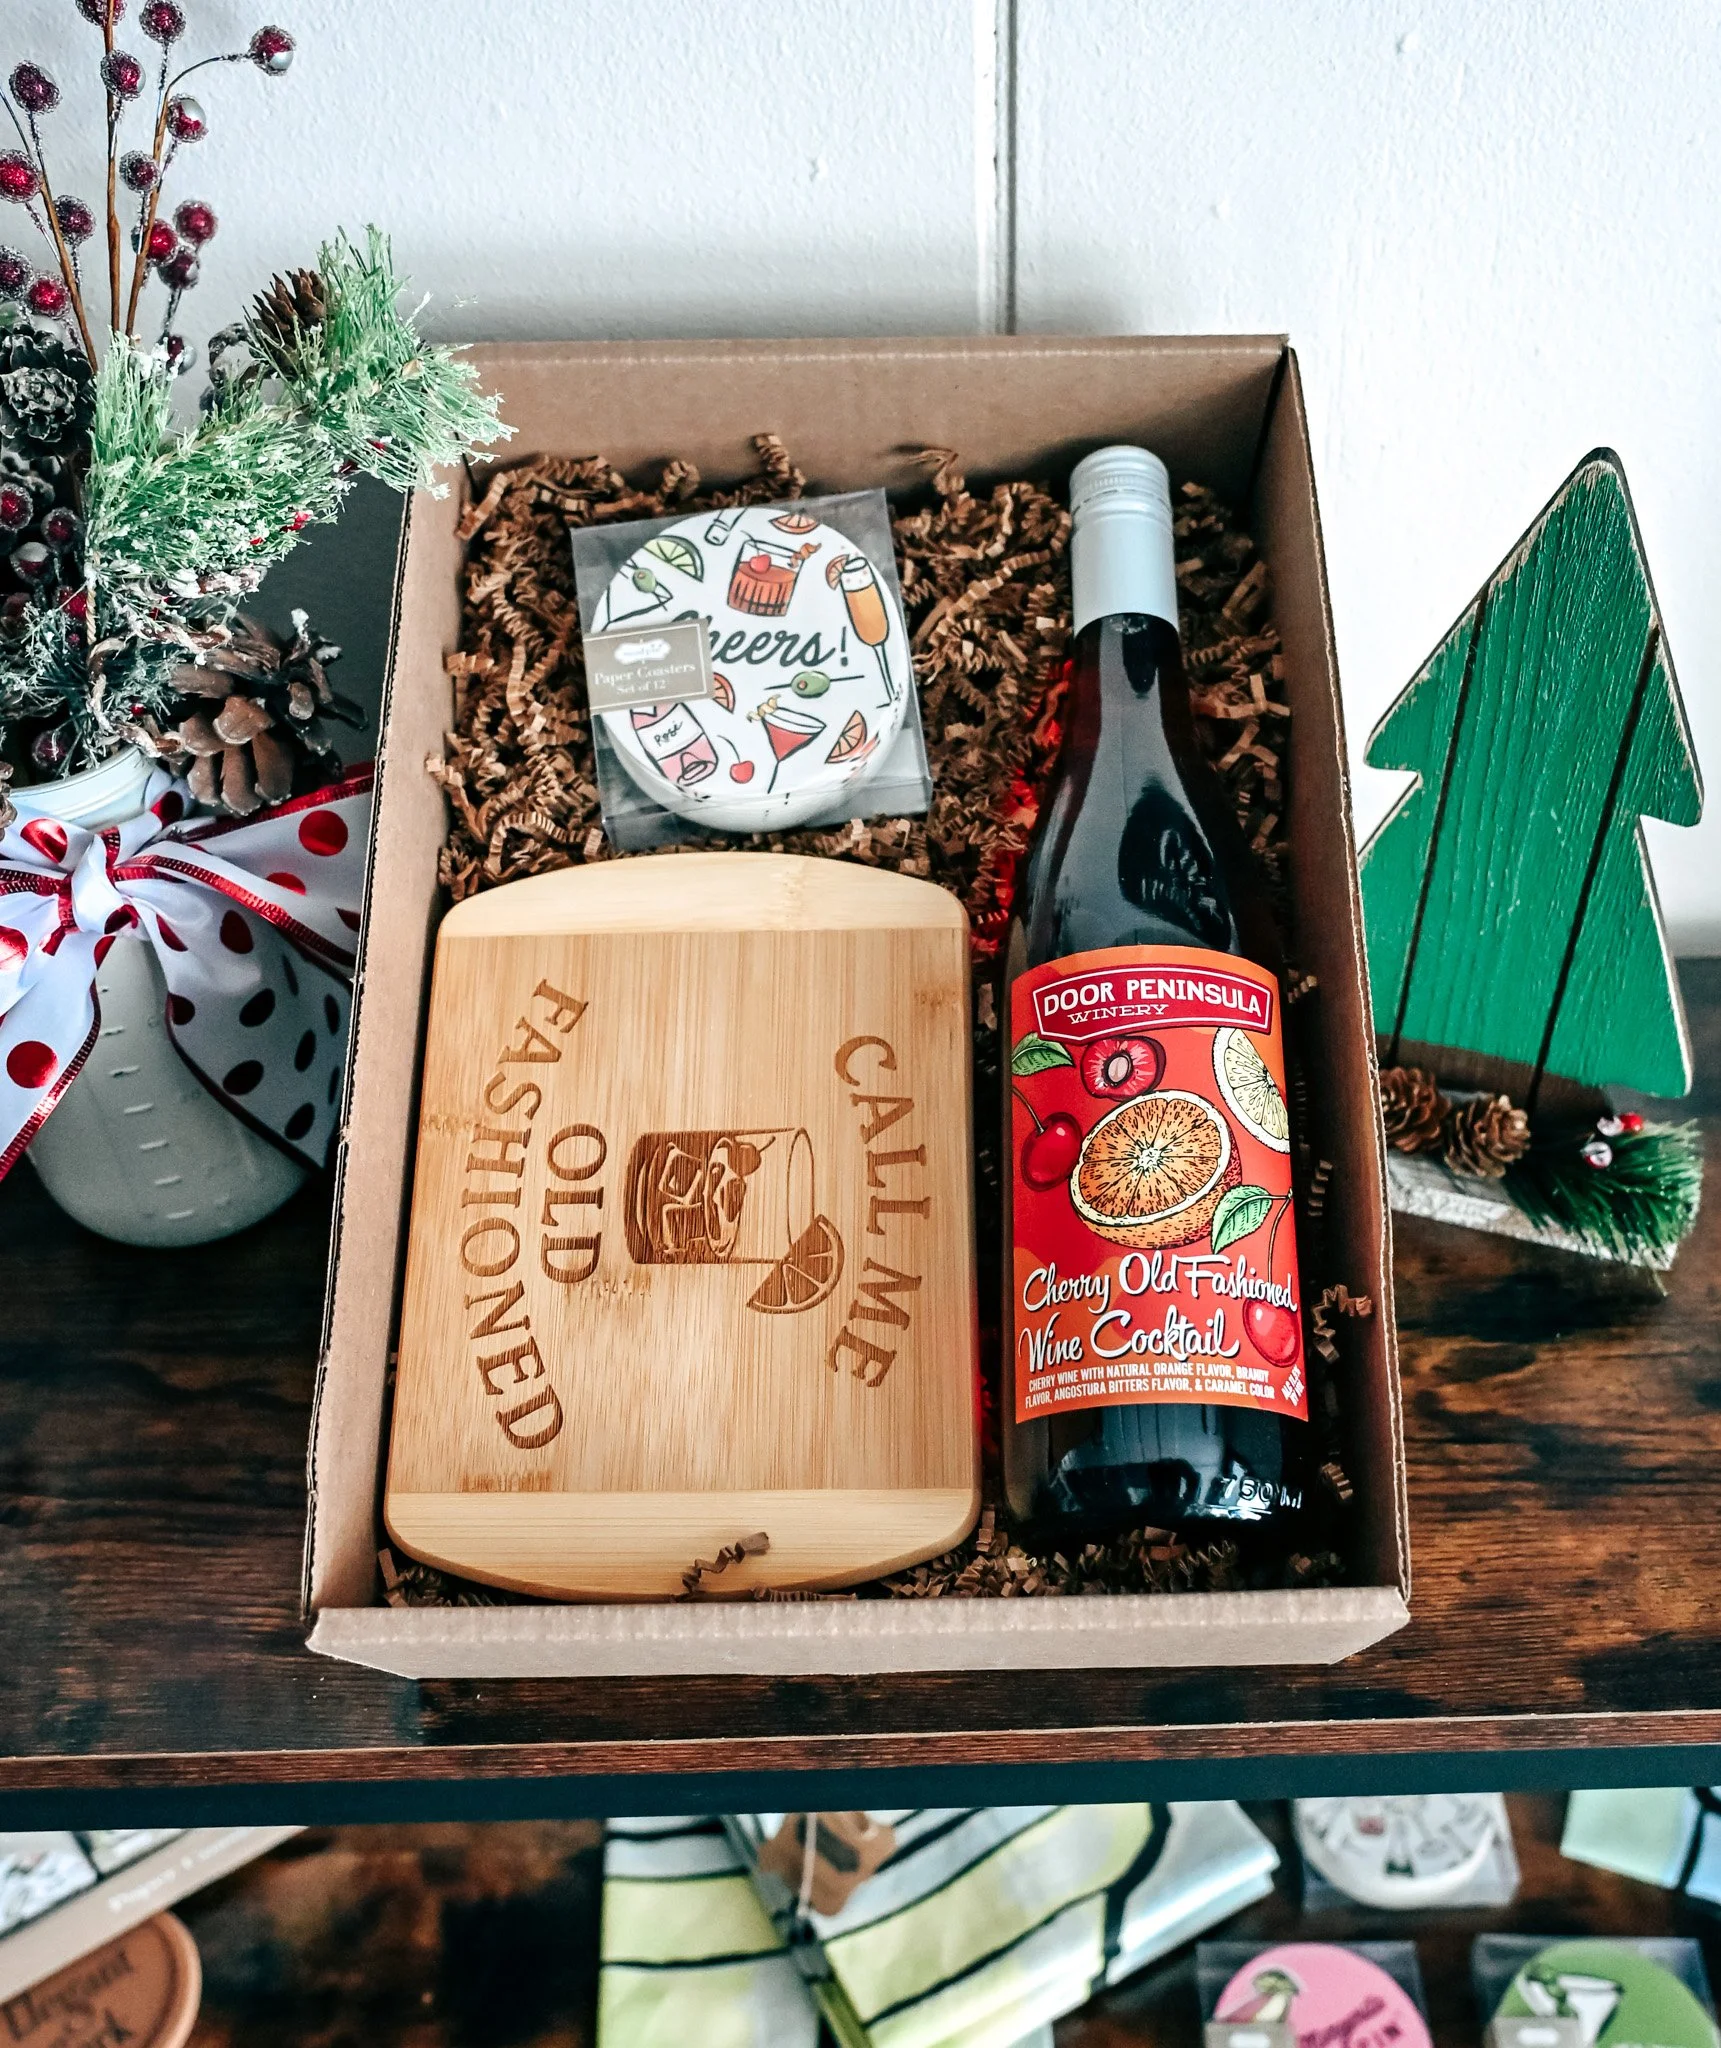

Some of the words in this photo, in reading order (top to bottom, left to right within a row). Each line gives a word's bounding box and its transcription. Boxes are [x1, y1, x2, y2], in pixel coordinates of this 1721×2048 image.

[594, 671, 634, 687] Paper
[637, 663, 697, 679] Coasters
[617, 685, 635, 695] Set
[638, 681, 650, 693] of
[654, 679, 667, 691] 12
[1043, 981, 1114, 1017] DOOR
[1126, 978, 1262, 1018] PENINSULA
[1067, 1003, 1170, 1025] WINERY
[834, 1034, 931, 1237] CALL
[459, 978, 589, 1450] FASHIONED
[540, 1123, 608, 1285] OLD
[1023, 1262, 1111, 1315] Cherry
[1119, 1250, 1178, 1296] Old
[1175, 1254, 1298, 1312] Fashioned
[825, 1256, 923, 1389] ME
[1019, 1312, 1084, 1374] Wine
[1090, 1305, 1240, 1361] Cocktail
[1025, 1391, 1053, 1409] FLAVOR,
[1054, 1381, 1107, 1402] ANGOSTURA
[1108, 1378, 1150, 1394] BITTERS
[1151, 1377, 1193, 1393] FLAVOR,
[1194, 1378, 1203, 1392] &
[1204, 1378, 1249, 1396] CARAMEL
[1249, 1382, 1276, 1400] COLOR
[1028, 1374, 1056, 1393] CHERRY
[1057, 1369, 1079, 1385] WINE
[1080, 1366, 1105, 1381] WITH
[1106, 1362, 1152, 1379] NATURAL
[1153, 1362, 1195, 1376] ORANGE
[1196, 1362, 1235, 1380] FLAVOR,
[1236, 1365, 1270, 1383] BRANDY
